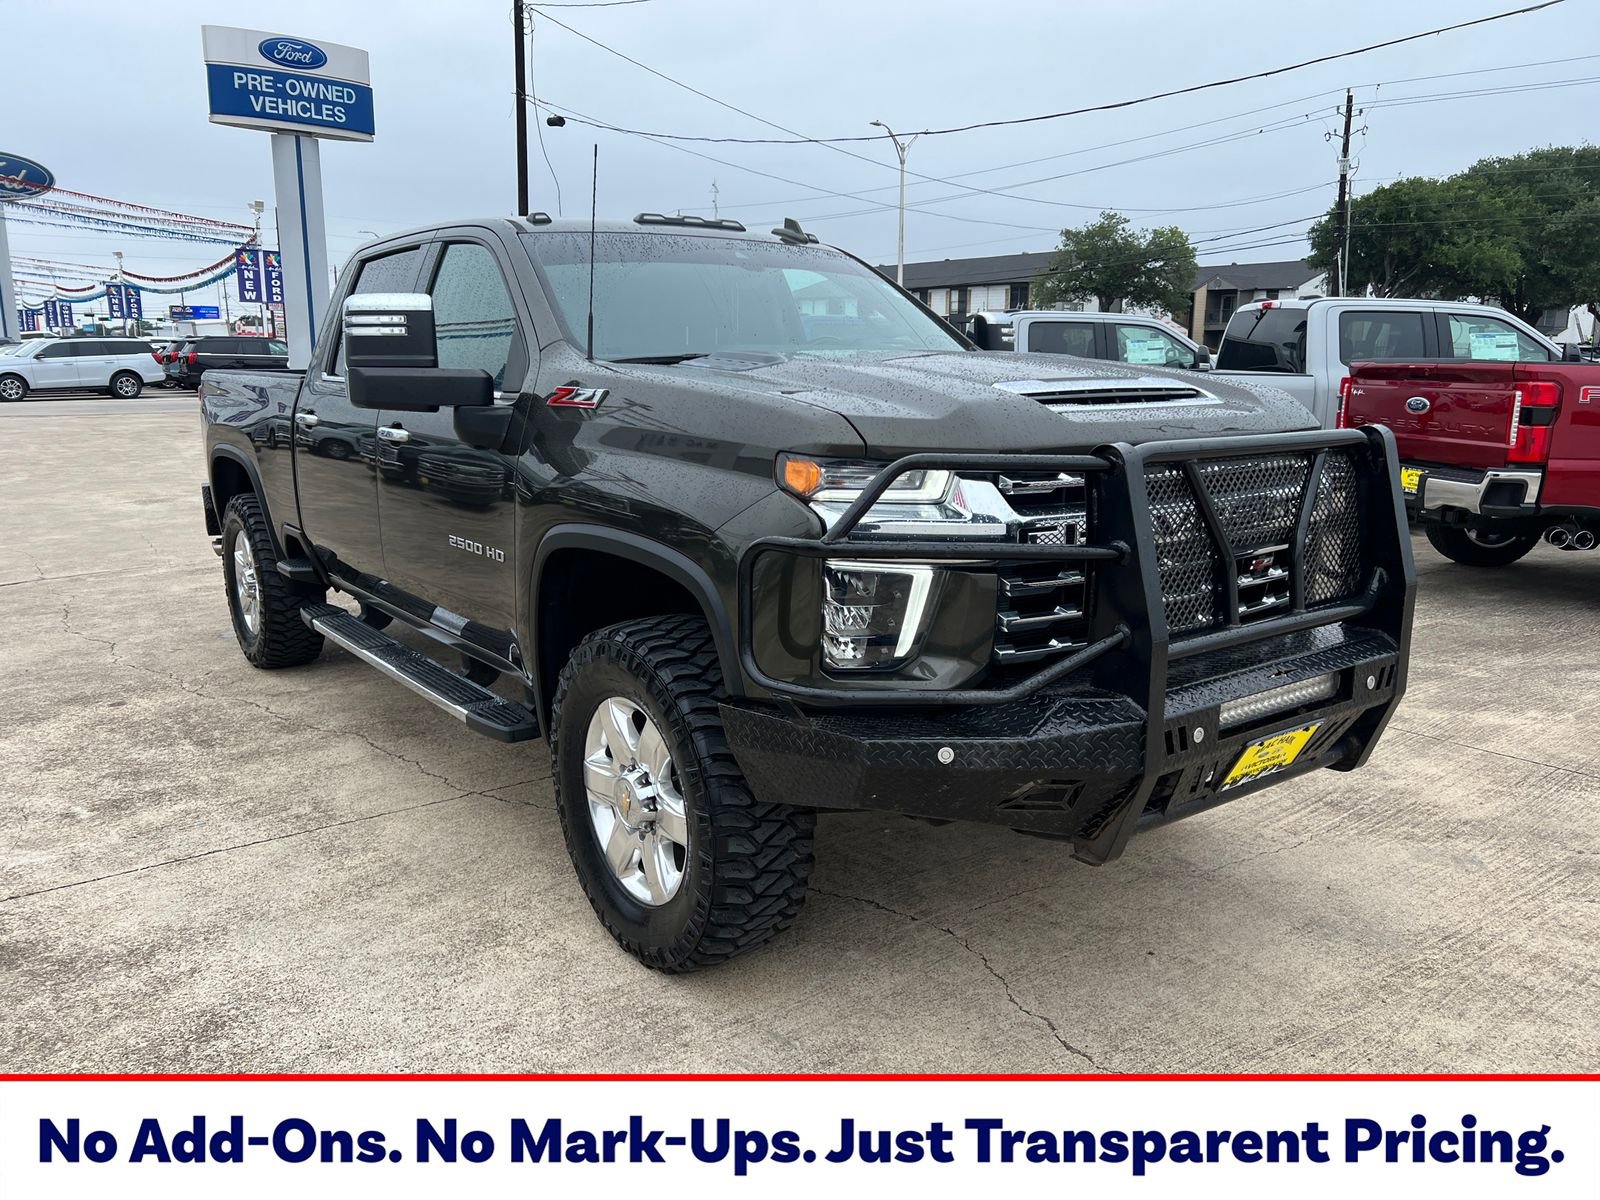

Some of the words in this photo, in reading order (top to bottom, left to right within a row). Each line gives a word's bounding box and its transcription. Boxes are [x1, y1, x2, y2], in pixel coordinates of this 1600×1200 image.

[274, 41, 312, 64] Ford
[250, 95, 347, 123] VEHICLES
[243, 269, 257, 300] NEW
[271, 271, 282, 302] FORD
[111, 298, 121, 318] NEW
[130, 298, 139, 318] FORD
[546, 386, 610, 409] Z71
[1427, 421, 1495, 436] DUTY
[448, 534, 483, 555] 2500
[486, 545, 505, 563] HD
